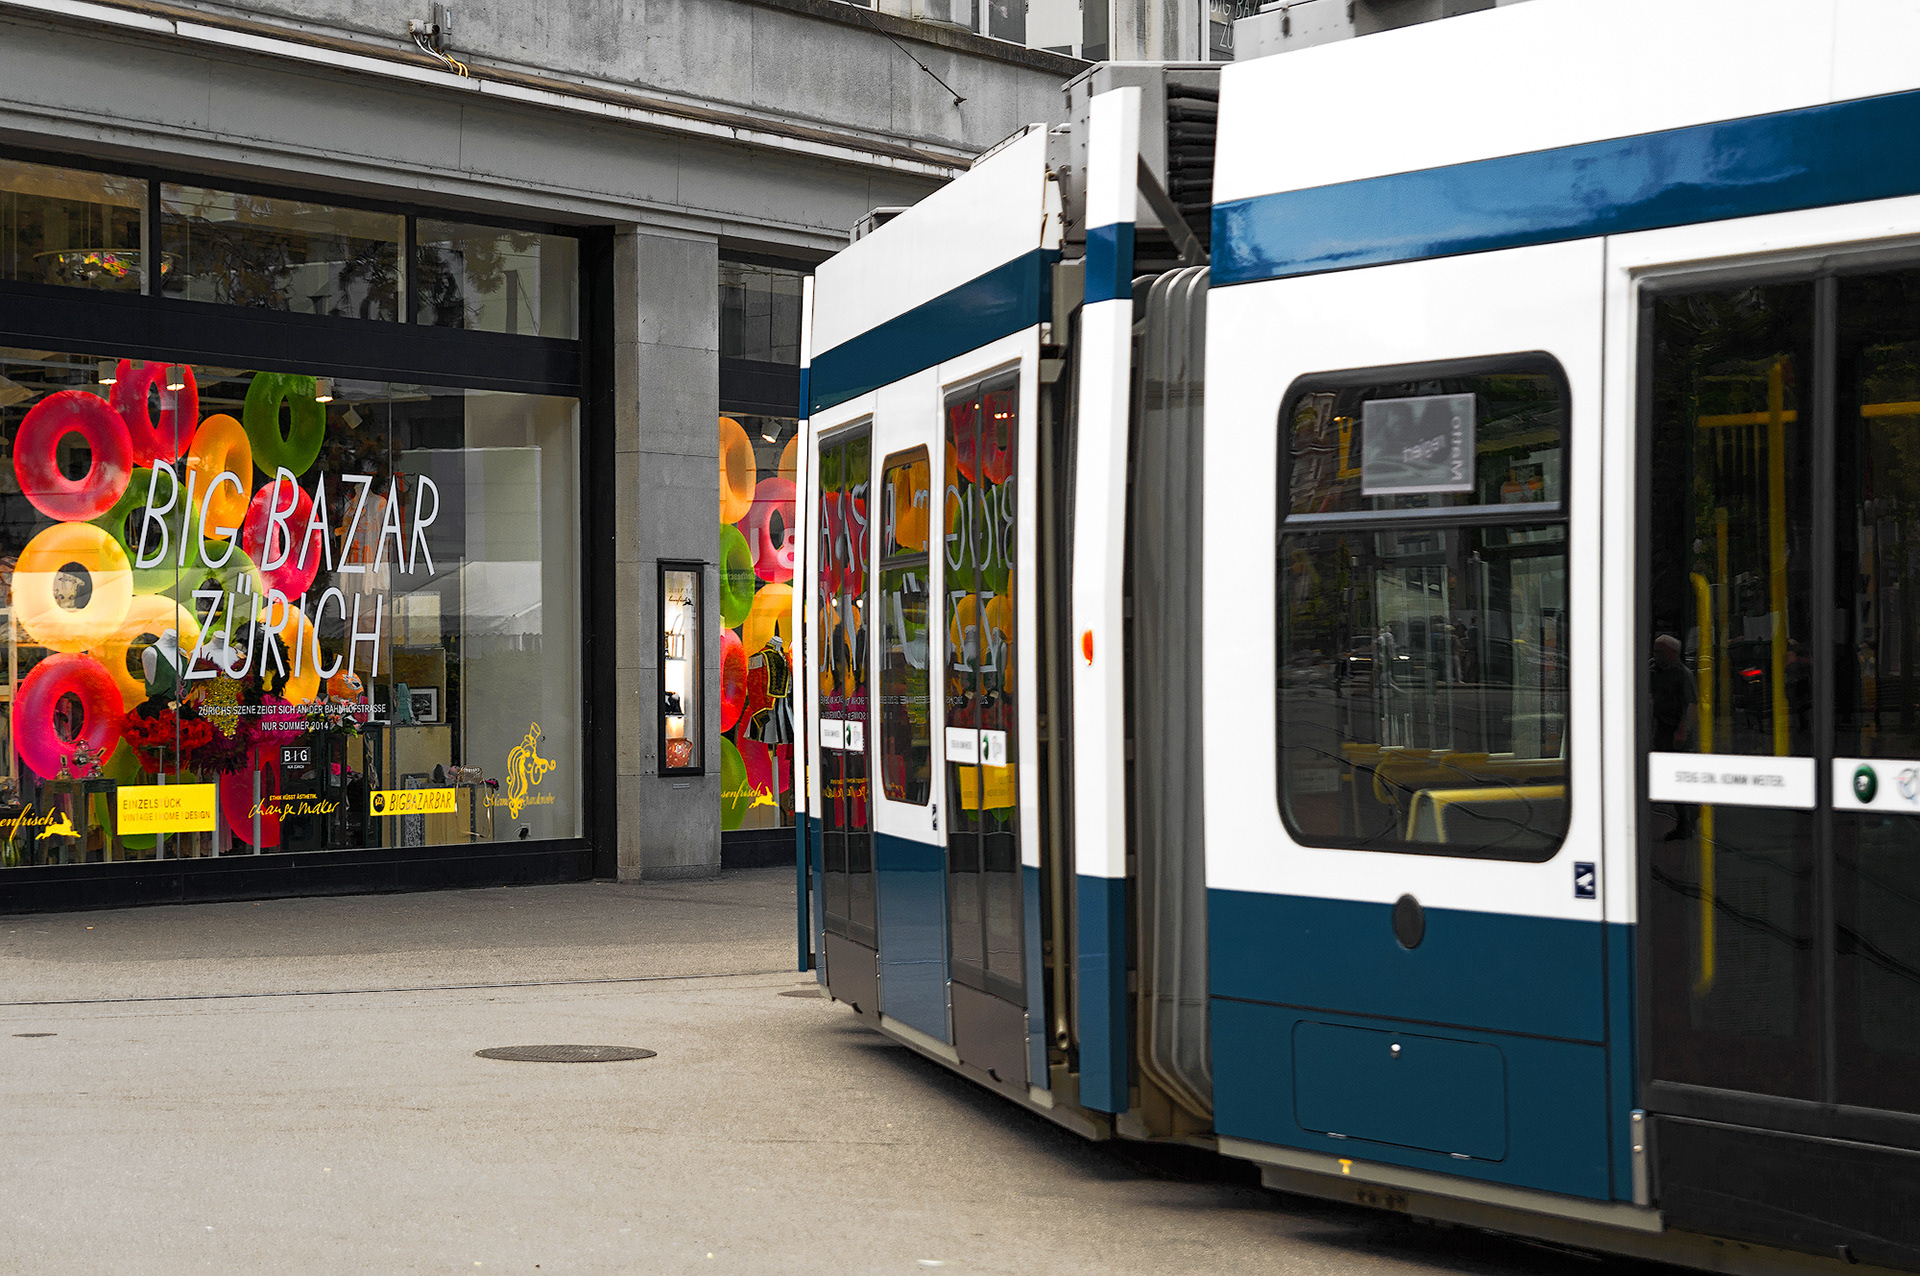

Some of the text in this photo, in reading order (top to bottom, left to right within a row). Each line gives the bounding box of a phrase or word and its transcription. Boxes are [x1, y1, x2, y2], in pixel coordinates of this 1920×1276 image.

[135, 457, 440, 577] BIG BAZAR
[183, 572, 383, 681] ZÜRICH
[198, 703, 387, 716] ZÜRICHS SZENE ZEIGT SICH AN DER BAHNHOFSTRASSE
[261, 721, 329, 731] NUR SOMMER 2014
[284, 749, 308, 762] BIG
[122, 810, 211, 822] VINTAGE HOME DESIGN
